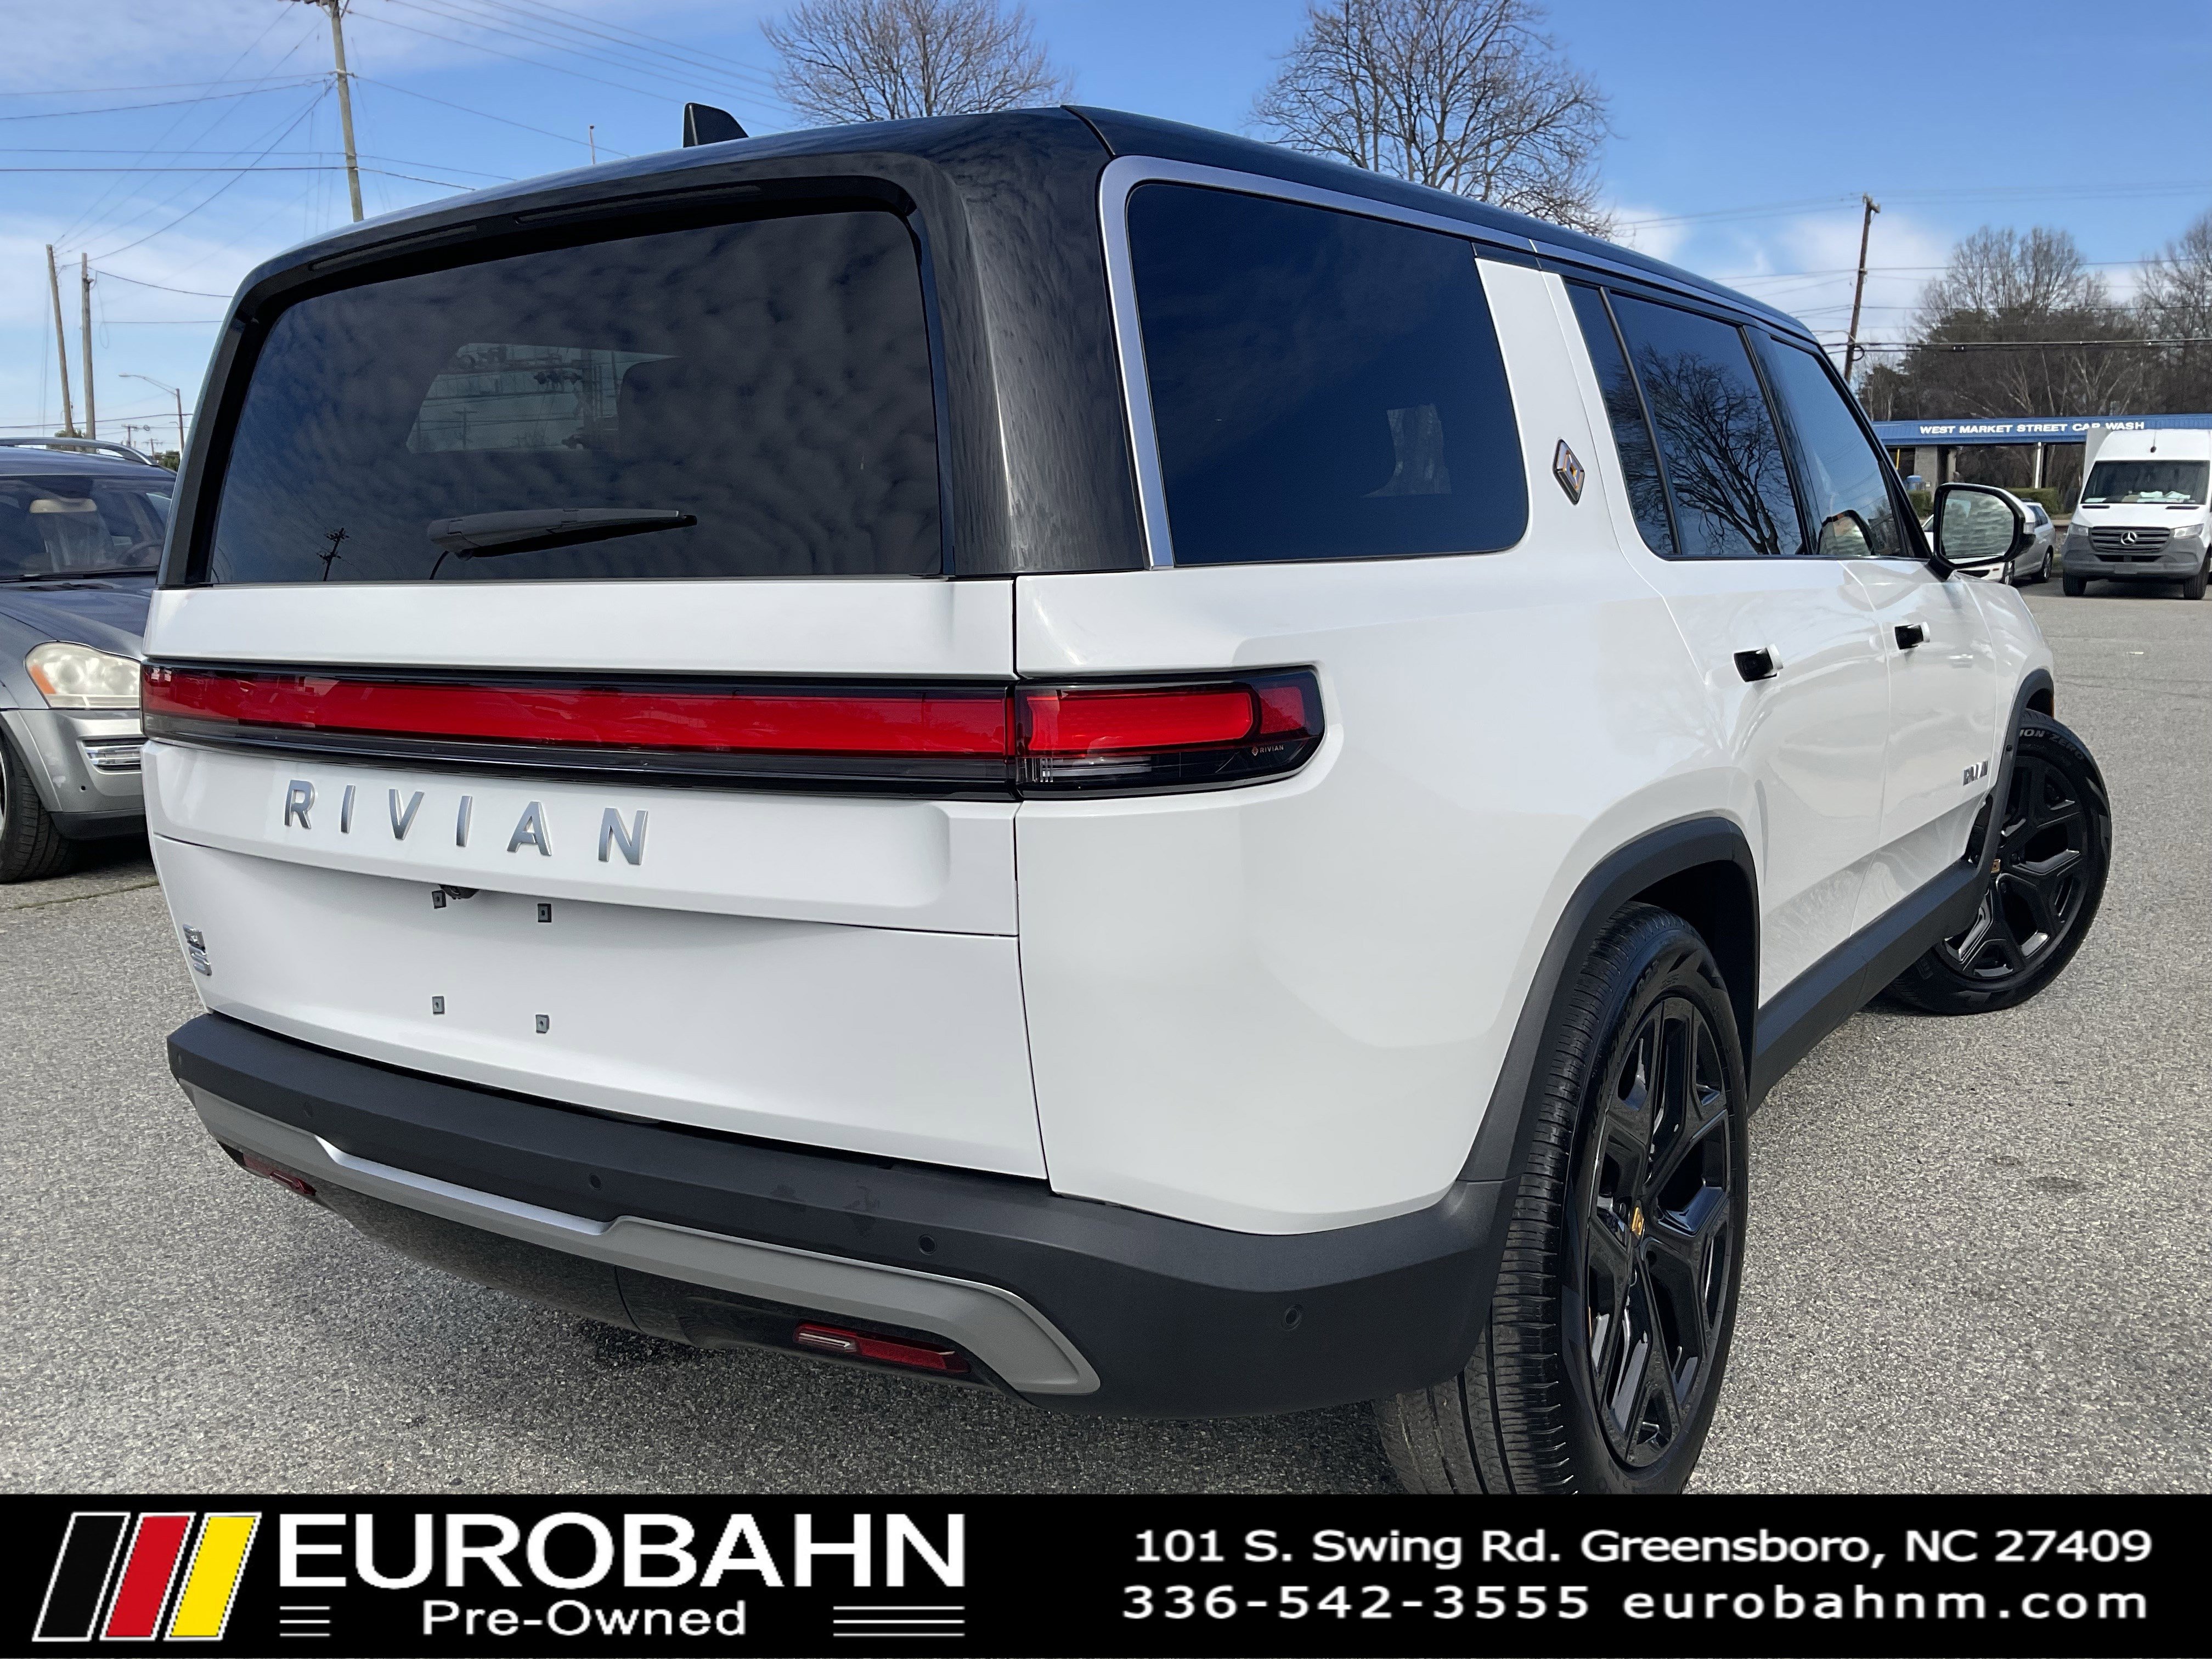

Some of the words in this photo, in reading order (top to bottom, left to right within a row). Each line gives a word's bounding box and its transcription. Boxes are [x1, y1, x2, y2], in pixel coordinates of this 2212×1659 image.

[1920, 426, 1956, 434] WEST
[1959, 425, 2013, 433] MARKET
[2016, 424, 2068, 432] STREET
[2105, 421, 2145, 430] WASH
[1260, 744, 1284, 753] RIVIAN
[284, 779, 650, 866] RIVIAN
